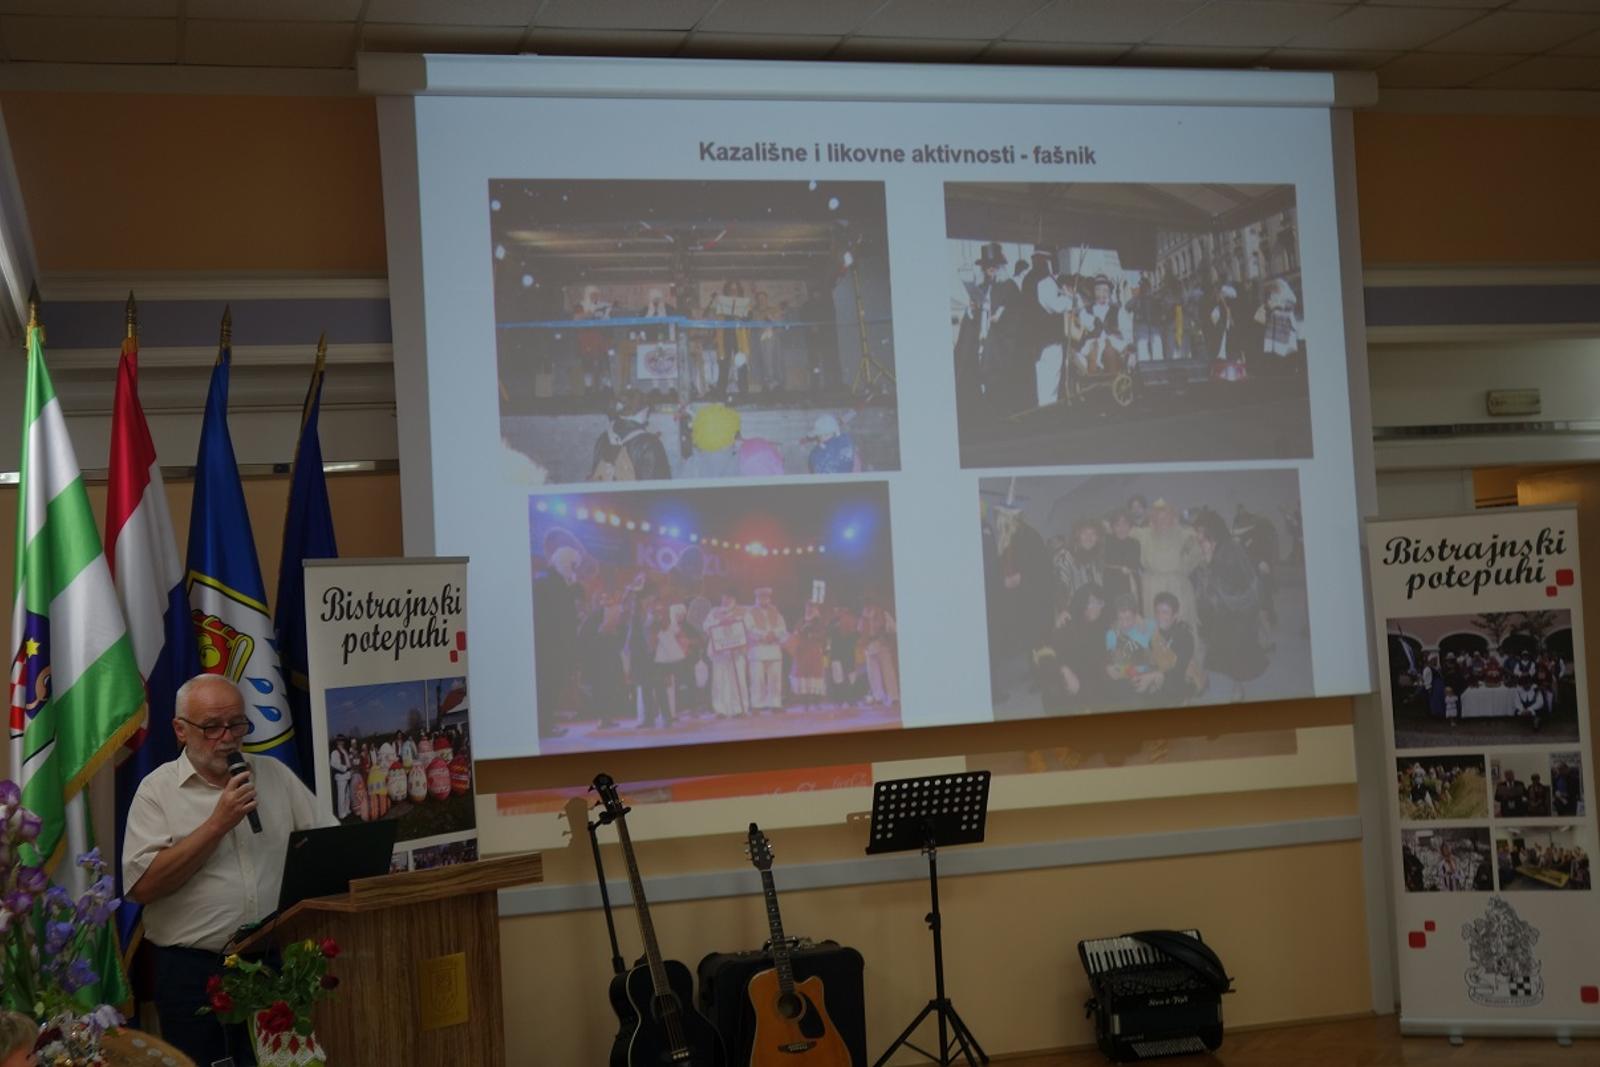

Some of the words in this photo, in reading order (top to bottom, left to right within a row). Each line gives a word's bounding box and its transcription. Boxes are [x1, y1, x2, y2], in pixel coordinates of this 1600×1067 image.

[699, 141, 808, 162] Kazališne
[814, 143, 820, 162] i
[827, 143, 906, 163] likovne
[911, 144, 1015, 164] aktivnosti
[1032, 145, 1097, 165] fašnik
[1383, 527, 1567, 568] Bistrajnski
[1405, 556, 1546, 600] potepuhi
[320, 583, 462, 628] Bistrajnski
[341, 615, 450, 665] potepuhi
